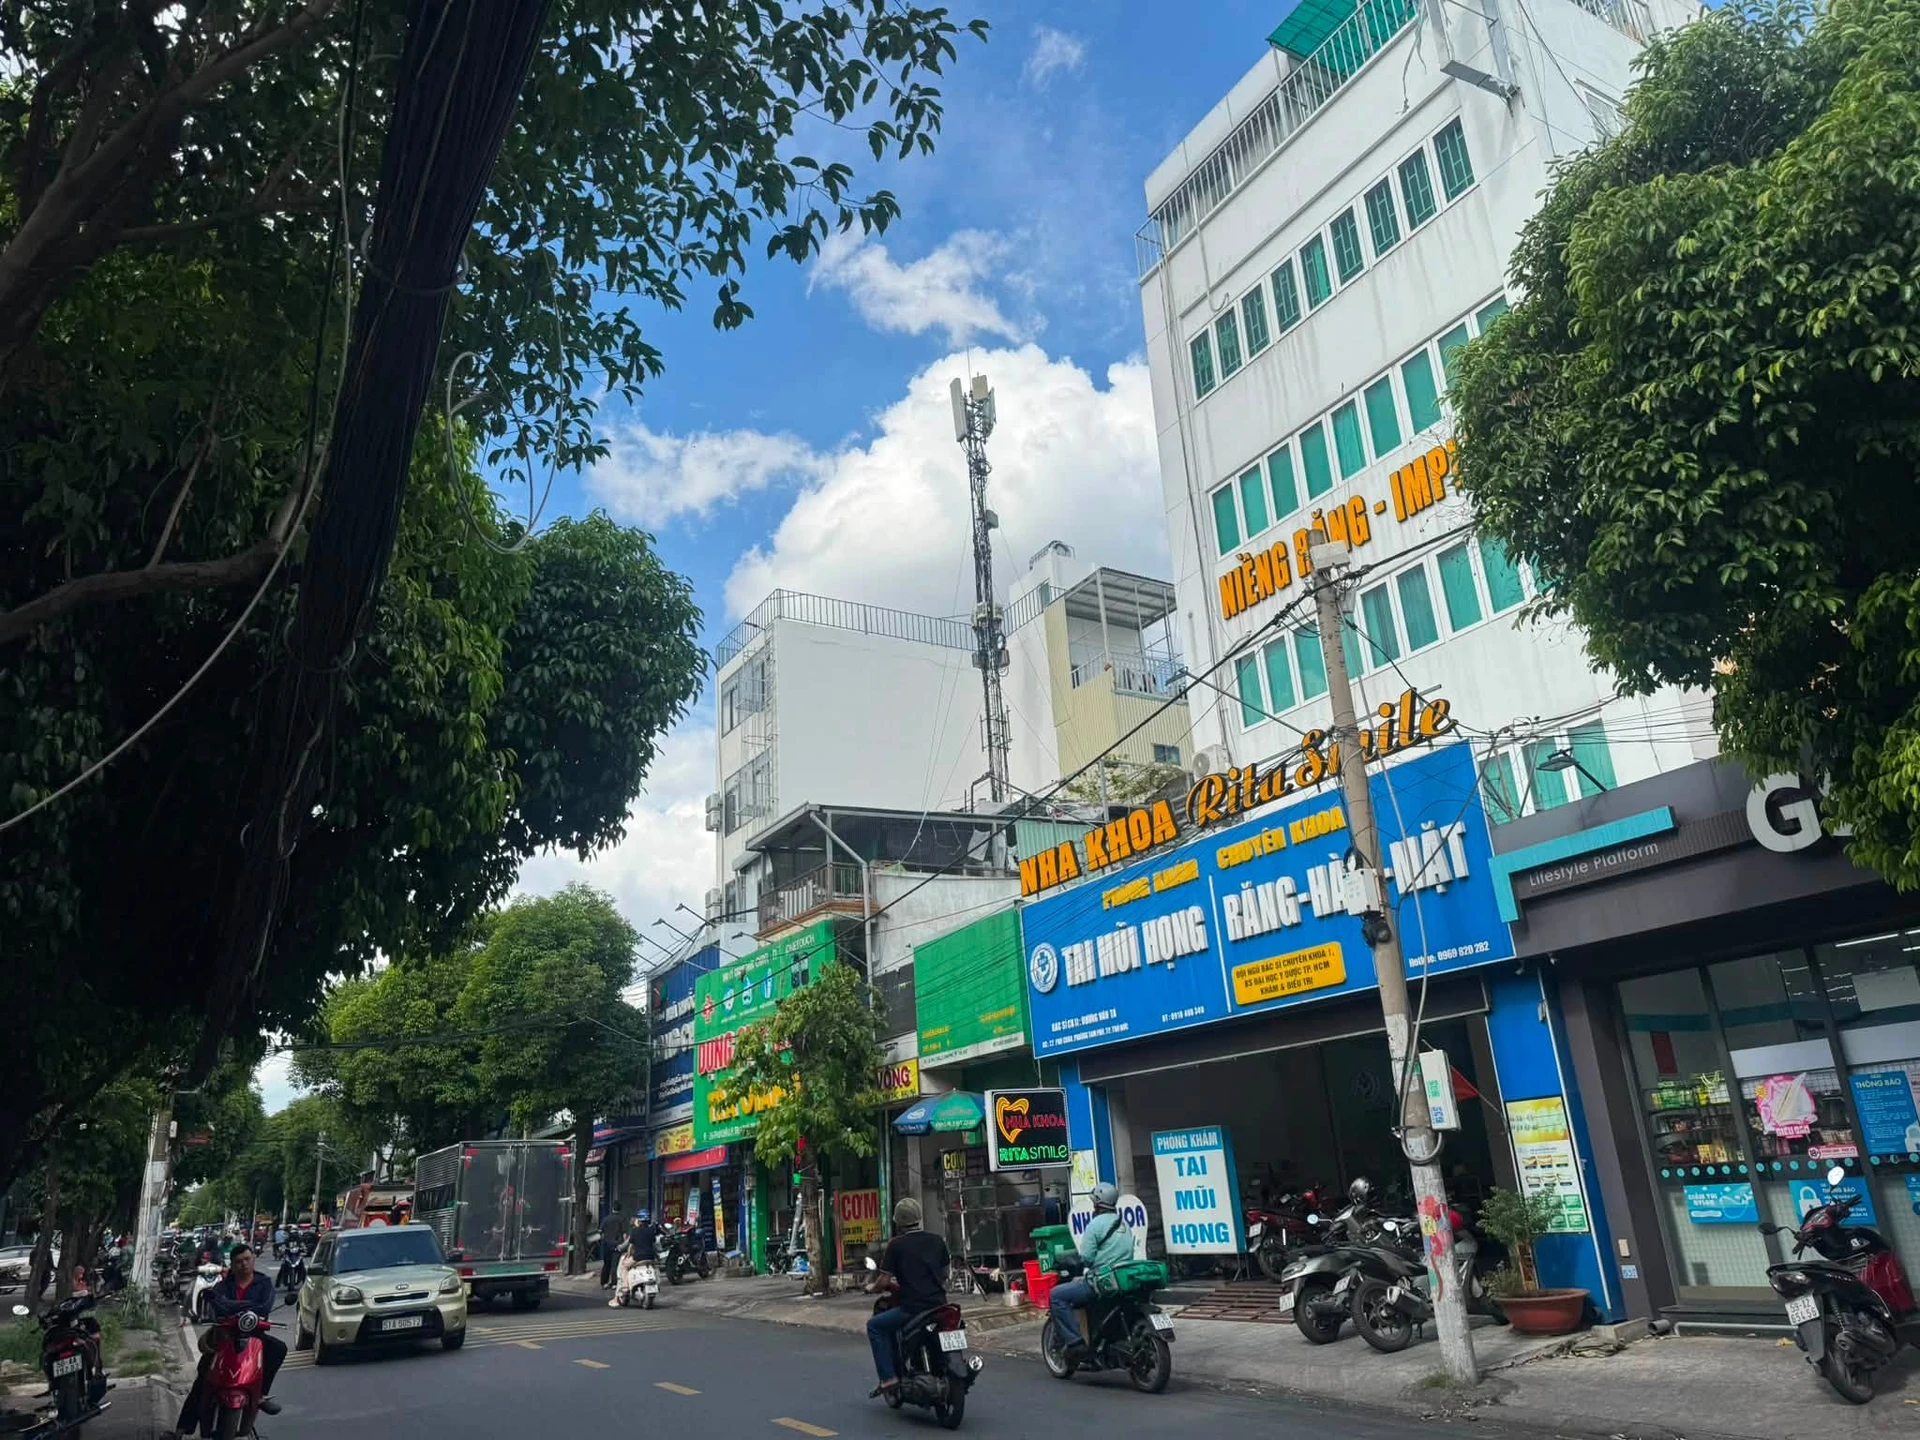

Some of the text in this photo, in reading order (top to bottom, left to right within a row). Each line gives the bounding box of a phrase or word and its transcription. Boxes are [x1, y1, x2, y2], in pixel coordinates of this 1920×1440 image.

[1219, 541, 1291, 620] NIỀNG
[1019, 840, 1081, 897] NHA
[1084, 800, 1179, 872] KHOA
[1216, 806, 1348, 869] CHUYÊN KHOA
[1530, 842, 1659, 887] Lifestyle Platform
[1061, 905, 1209, 986] TAI MŨI HỌNG
[1437, 947, 1457, 961] 0969
[1458, 944, 1474, 957] 820
[1474, 941, 1490, 954] 282
[1261, 962, 1274, 973] BÁC
[1282, 955, 1308, 967] CHUYÊN
[1308, 949, 1326, 961] KHOA
[1244, 979, 1253, 988] BS
[1313, 960, 1330, 971] HCM
[1260, 984, 1279, 995] KHÁM
[1280, 982, 1285, 991] &
[1005, 1114, 1066, 1129] NHA KHOA
[1157, 1131, 1218, 1150] PHÒNG KHÁM
[1174, 1155, 1207, 1177] TAI
[1174, 1185, 1216, 1210] MŨI
[1170, 1222, 1230, 1248] HỌNG
